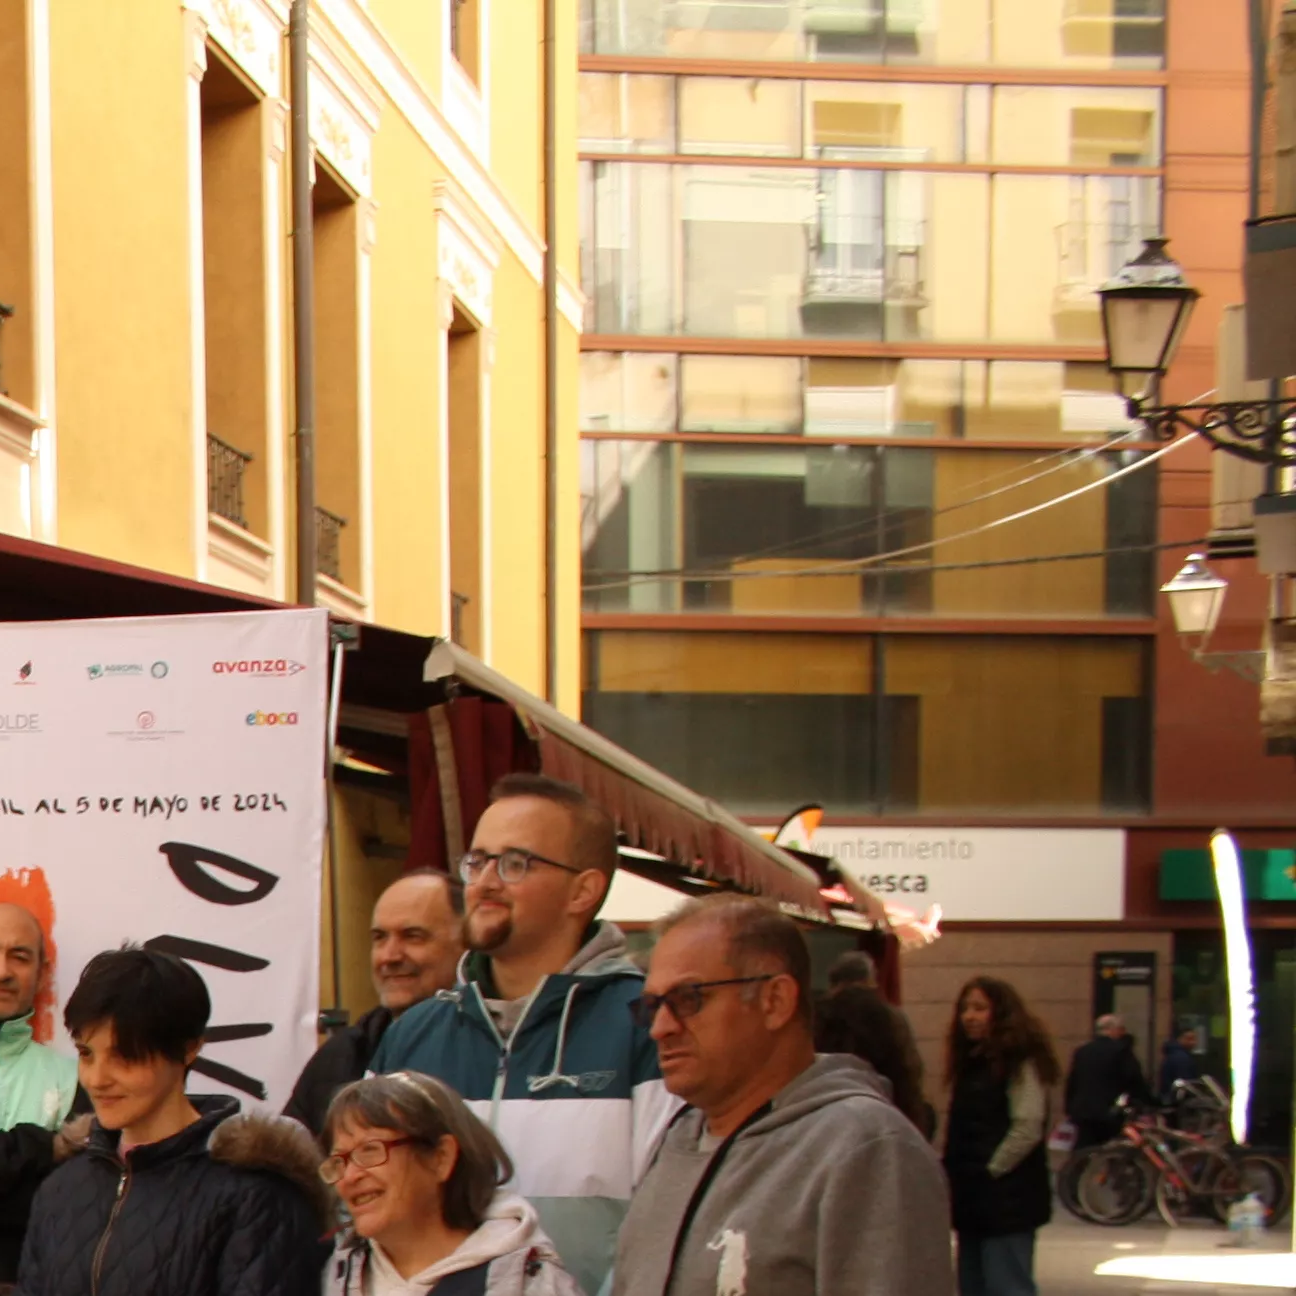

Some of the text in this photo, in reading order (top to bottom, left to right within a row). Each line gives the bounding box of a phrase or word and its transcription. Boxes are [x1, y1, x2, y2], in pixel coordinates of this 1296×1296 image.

[212, 659, 287, 673] avanza
[246, 710, 298, 726] eboca
[35, 799, 66, 814] AL
[76, 796, 89, 814] 5
[99, 797, 124, 813] DE
[133, 794, 188, 820] MAYO
[200, 795, 222, 811] DE
[234, 793, 287, 811] 2024
[810, 835, 974, 860] yuntamiento
[860, 873, 929, 893] esca
